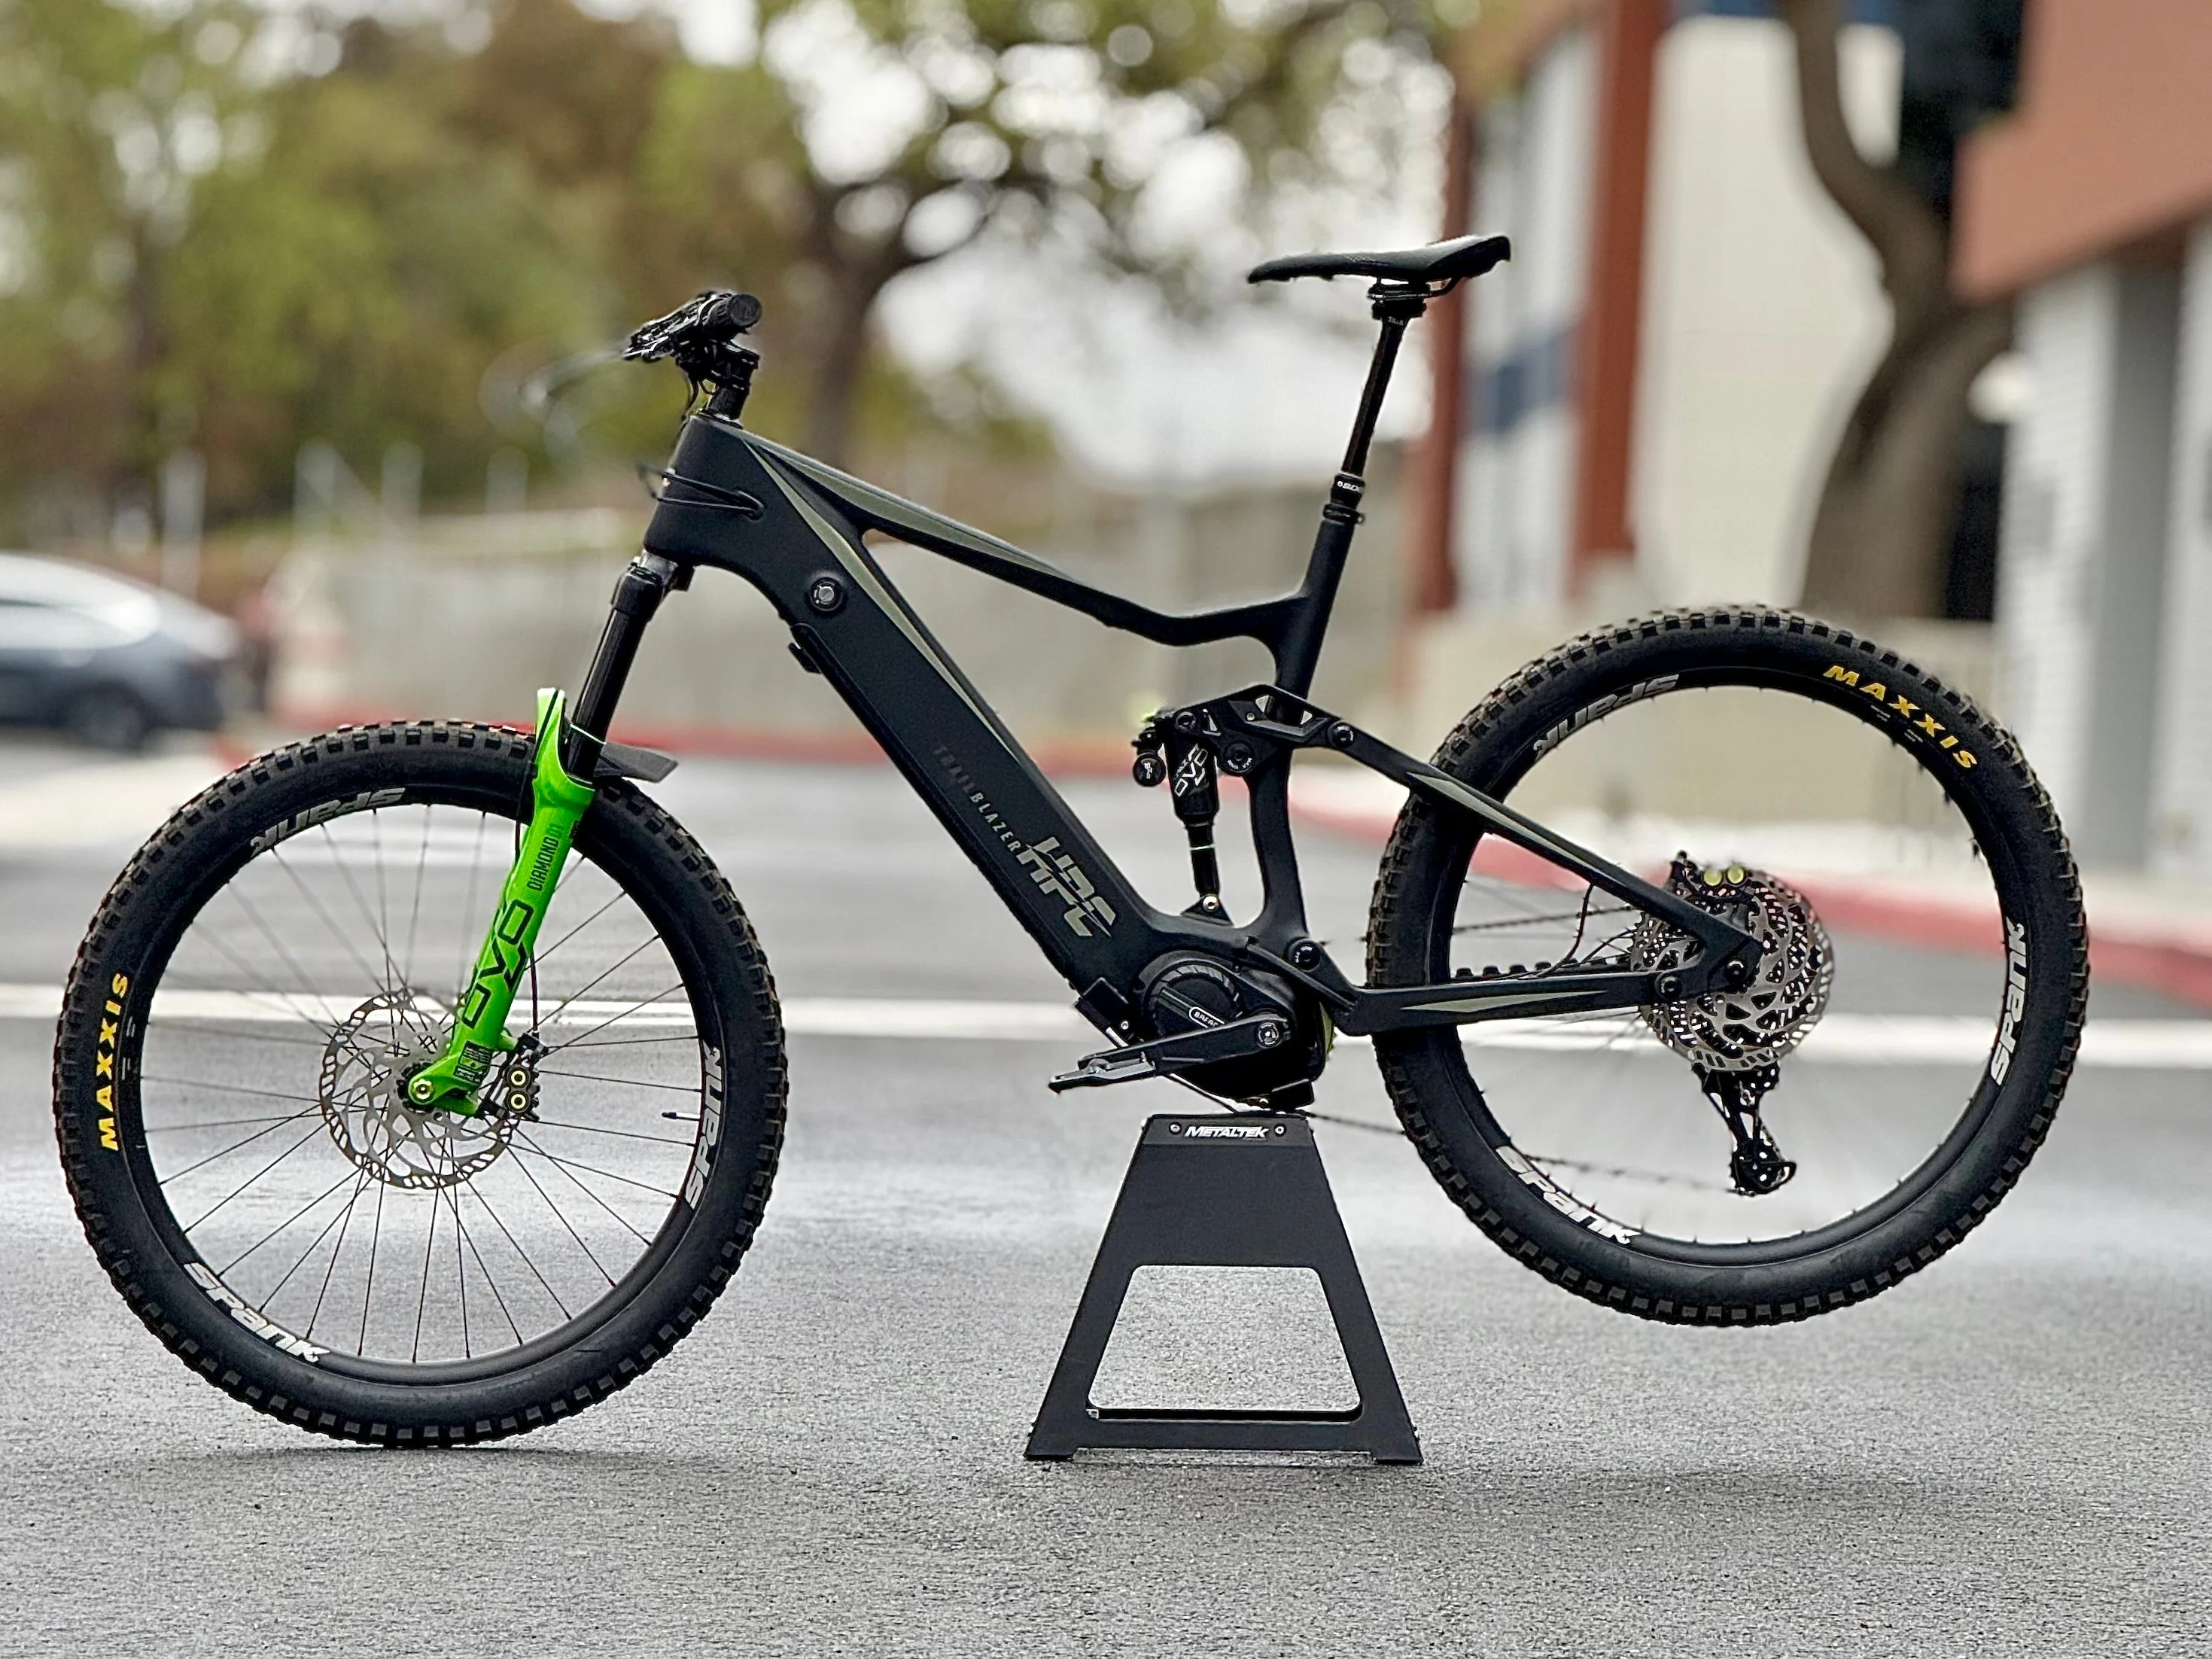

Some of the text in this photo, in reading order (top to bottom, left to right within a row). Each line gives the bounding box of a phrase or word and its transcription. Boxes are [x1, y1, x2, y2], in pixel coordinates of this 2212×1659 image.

[1822, 665, 1978, 769] MAXXIS
[933, 744, 1021, 852] TRAILBLAZER
[526, 836, 559, 892] DIAMOND
[1016, 836, 1116, 937] HPC
[96, 973, 129, 1152] MAXXIS
[1185, 1126, 1270, 1138] METALTEK
